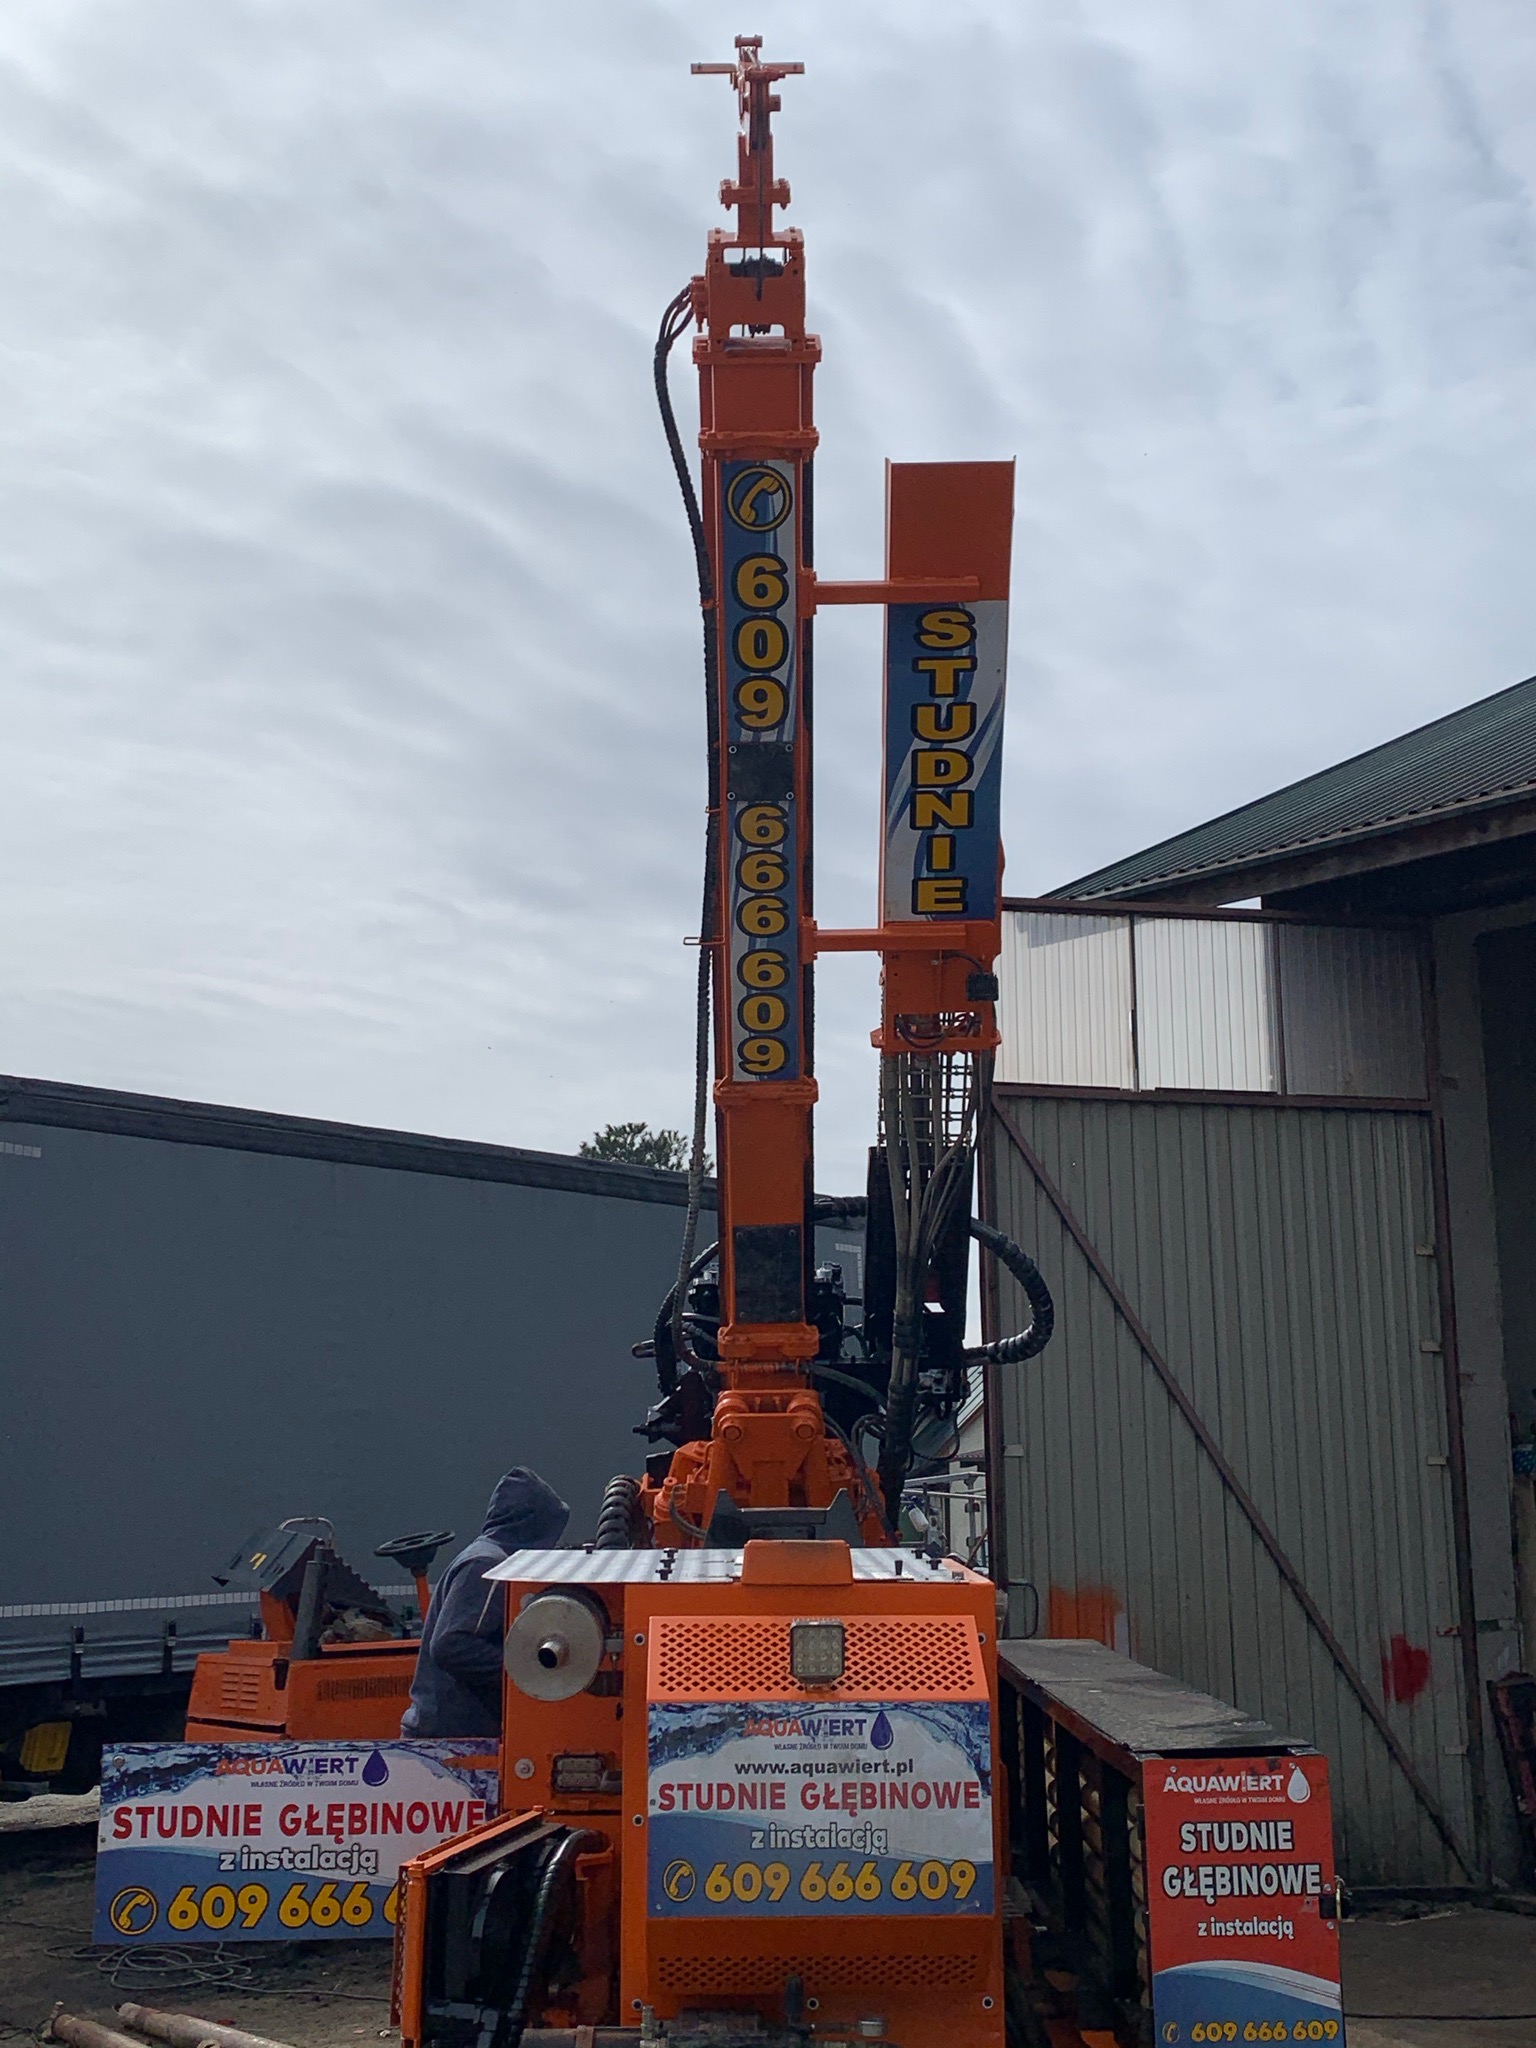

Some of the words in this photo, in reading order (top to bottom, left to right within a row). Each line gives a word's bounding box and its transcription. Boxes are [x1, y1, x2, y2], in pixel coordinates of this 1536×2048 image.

[732, 552, 789, 732] 609
[910, 606, 978, 916] STUDNIE
[735, 802, 789, 939] 666
[737, 948, 789, 1075] 609
[734, 1758, 914, 1777] www.aquawiert.pl
[658, 1782, 786, 1811] STUDNIE
[800, 1781, 981, 1817] GŁĘBINOWE
[112, 1804, 262, 1839] STUDNIE
[279, 1800, 485, 1844] GŁĘBINOWE
[751, 1828, 765, 1850] z
[769, 1821, 888, 1855] instalacją
[1180, 1820, 1294, 1852] STUDNIE
[219, 1851, 236, 1871] z
[241, 1844, 377, 1874] instalacją
[703, 1861, 791, 1902] 609
[800, 1861, 883, 1902] 666
[890, 1859, 978, 1901] 609
[1162, 1863, 1322, 1906] GŁĘBINOWE
[167, 1883, 270, 1931] 609
[278, 1882, 374, 1929] 666
[1197, 1920, 1208, 1938] z
[1210, 1915, 1295, 1940] instalacją
[1190, 2021, 1238, 2043] 609
[1243, 2020, 1288, 2042] 666
[1292, 2019, 1339, 2041] 609
